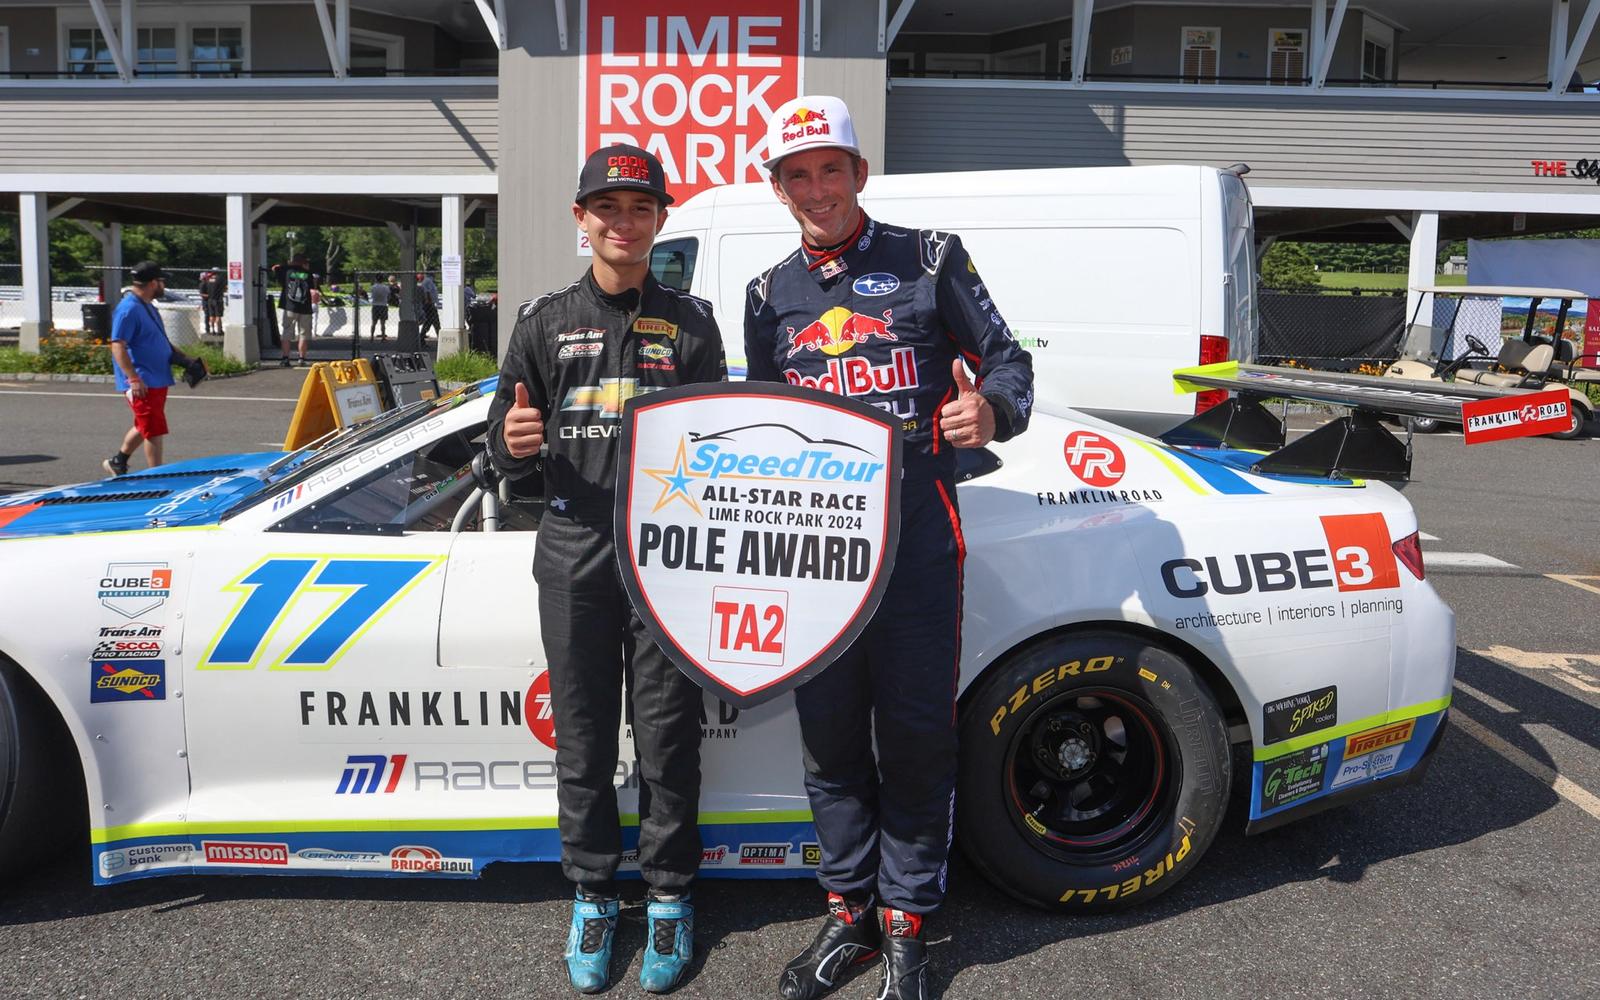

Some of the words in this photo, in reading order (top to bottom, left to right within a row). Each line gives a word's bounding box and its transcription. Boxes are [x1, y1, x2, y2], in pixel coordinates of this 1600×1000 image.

[601, 15, 783, 68] LIME
[599, 73, 782, 127] ROCK
[782, 127, 805, 143] Red
[805, 122, 831, 136] Bull
[599, 132, 772, 185] ARK
[607, 155, 649, 168] COOK
[1531, 160, 1567, 177] THE
[557, 332, 586, 342] Trans
[585, 330, 604, 339] Am
[640, 346, 672, 356] SUNOCO
[842, 347, 919, 397] Bull
[1469, 410, 1518, 428] FRANKLIN
[1540, 402, 1567, 416] ROAD
[690, 443, 884, 483] SpeedTour
[702, 485, 802, 507] ALL-STAR
[810, 493, 867, 511] RACE
[1037, 490, 1118, 506] FRANKLIN
[1120, 489, 1163, 501] ROAD
[708, 506, 740, 522] LIME
[744, 511, 783, 525] ROCK
[786, 513, 823, 528] PARK
[828, 515, 862, 530] 2024
[638, 522, 726, 573] POLE
[736, 530, 872, 582] AWARD
[196, 553, 447, 671] 17
[1175, 611, 1262, 630] architecture
[1277, 602, 1336, 621] interiors
[1351, 597, 1403, 617] planning
[98, 627, 136, 637] Trans
[137, 627, 162, 637] Am
[714, 601, 785, 654] TA2
[115, 642, 160, 650] SCCA
[98, 675, 161, 688] SUNOCO
[300, 690, 522, 726] FRANKLIN
[1290, 691, 1334, 733] SPIKED
[1315, 713, 1335, 724] coolers
[701, 728, 738, 739] MPANY
[1347, 723, 1411, 756] PIRELLI
[129, 844, 193, 855] customers
[129, 855, 161, 866] bank
[1058, 835, 1192, 904] PIRELLI
